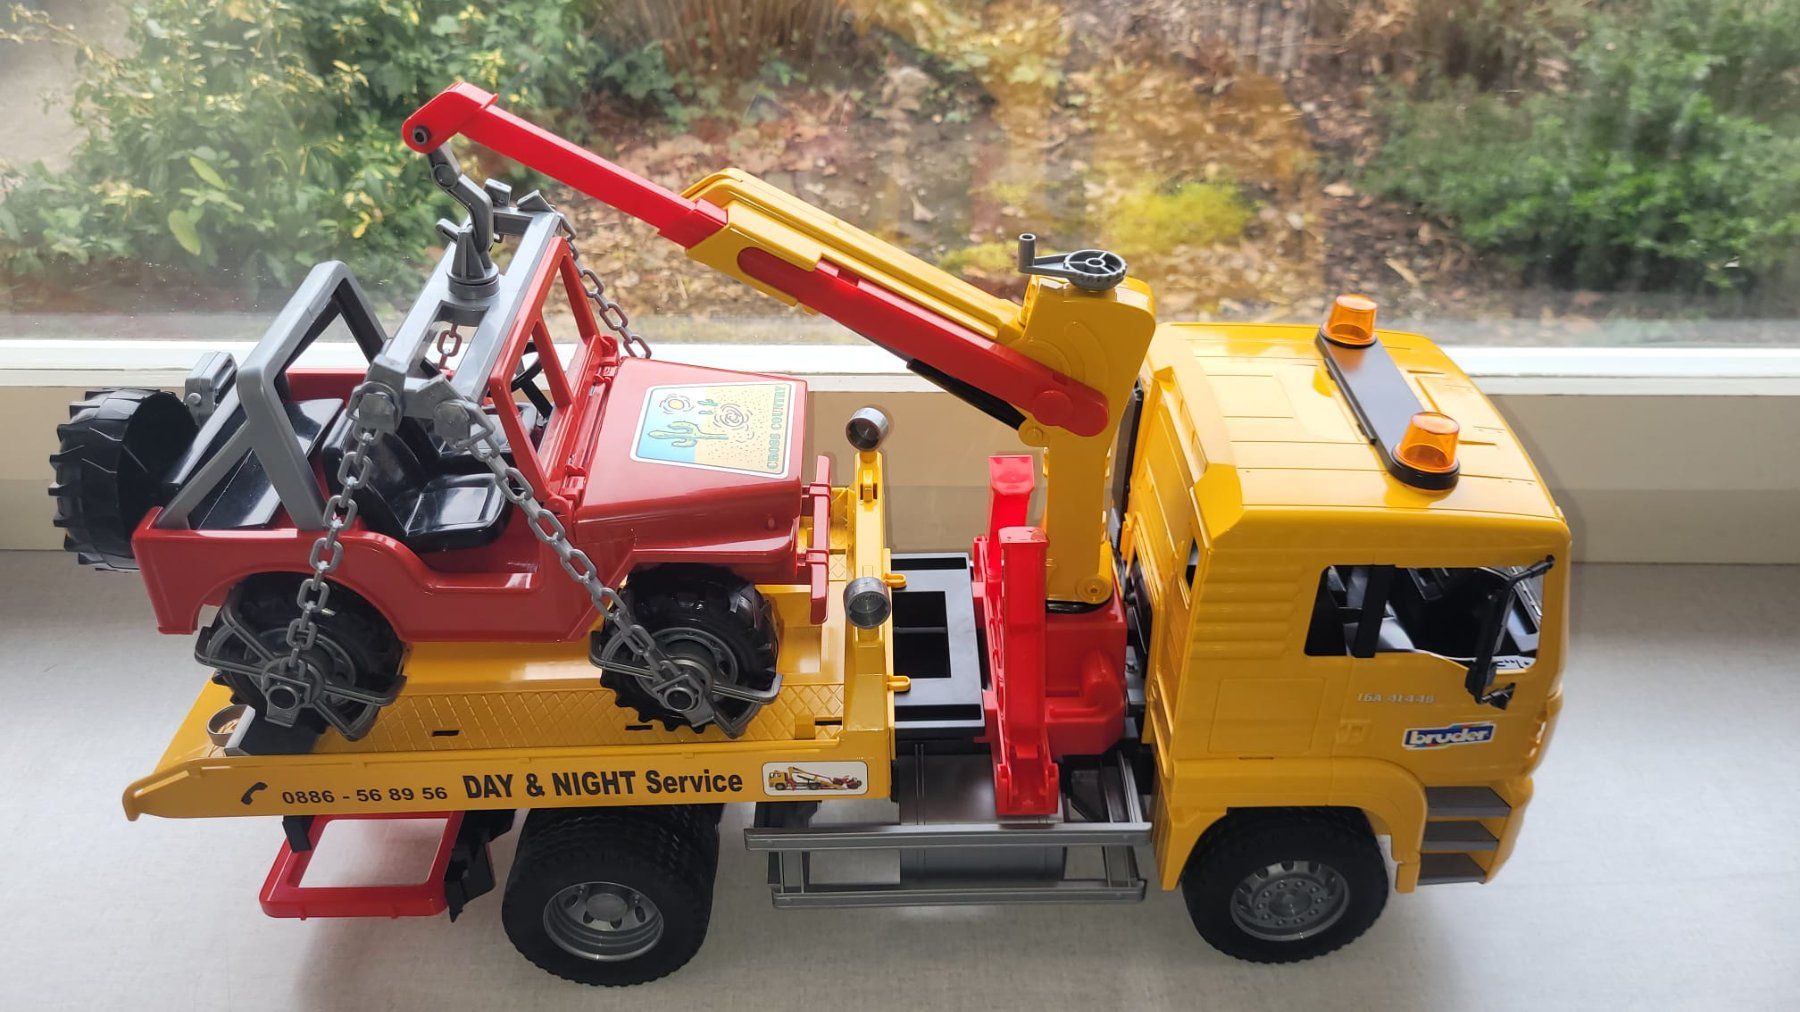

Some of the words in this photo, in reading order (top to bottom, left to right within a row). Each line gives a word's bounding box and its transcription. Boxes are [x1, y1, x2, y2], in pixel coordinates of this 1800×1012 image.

[771, 385, 786, 430] COUNTRY
[767, 433, 781, 470] CROSS
[1409, 729, 1489, 745] bruder
[282, 790, 335, 804] 0886
[356, 788, 382, 802] 56
[388, 787, 414, 801] 89
[421, 786, 448, 800] 56
[462, 774, 513, 799] DAY
[525, 773, 545, 797] &
[551, 770, 636, 796] NIGHT
[645, 769, 743, 793] Service
